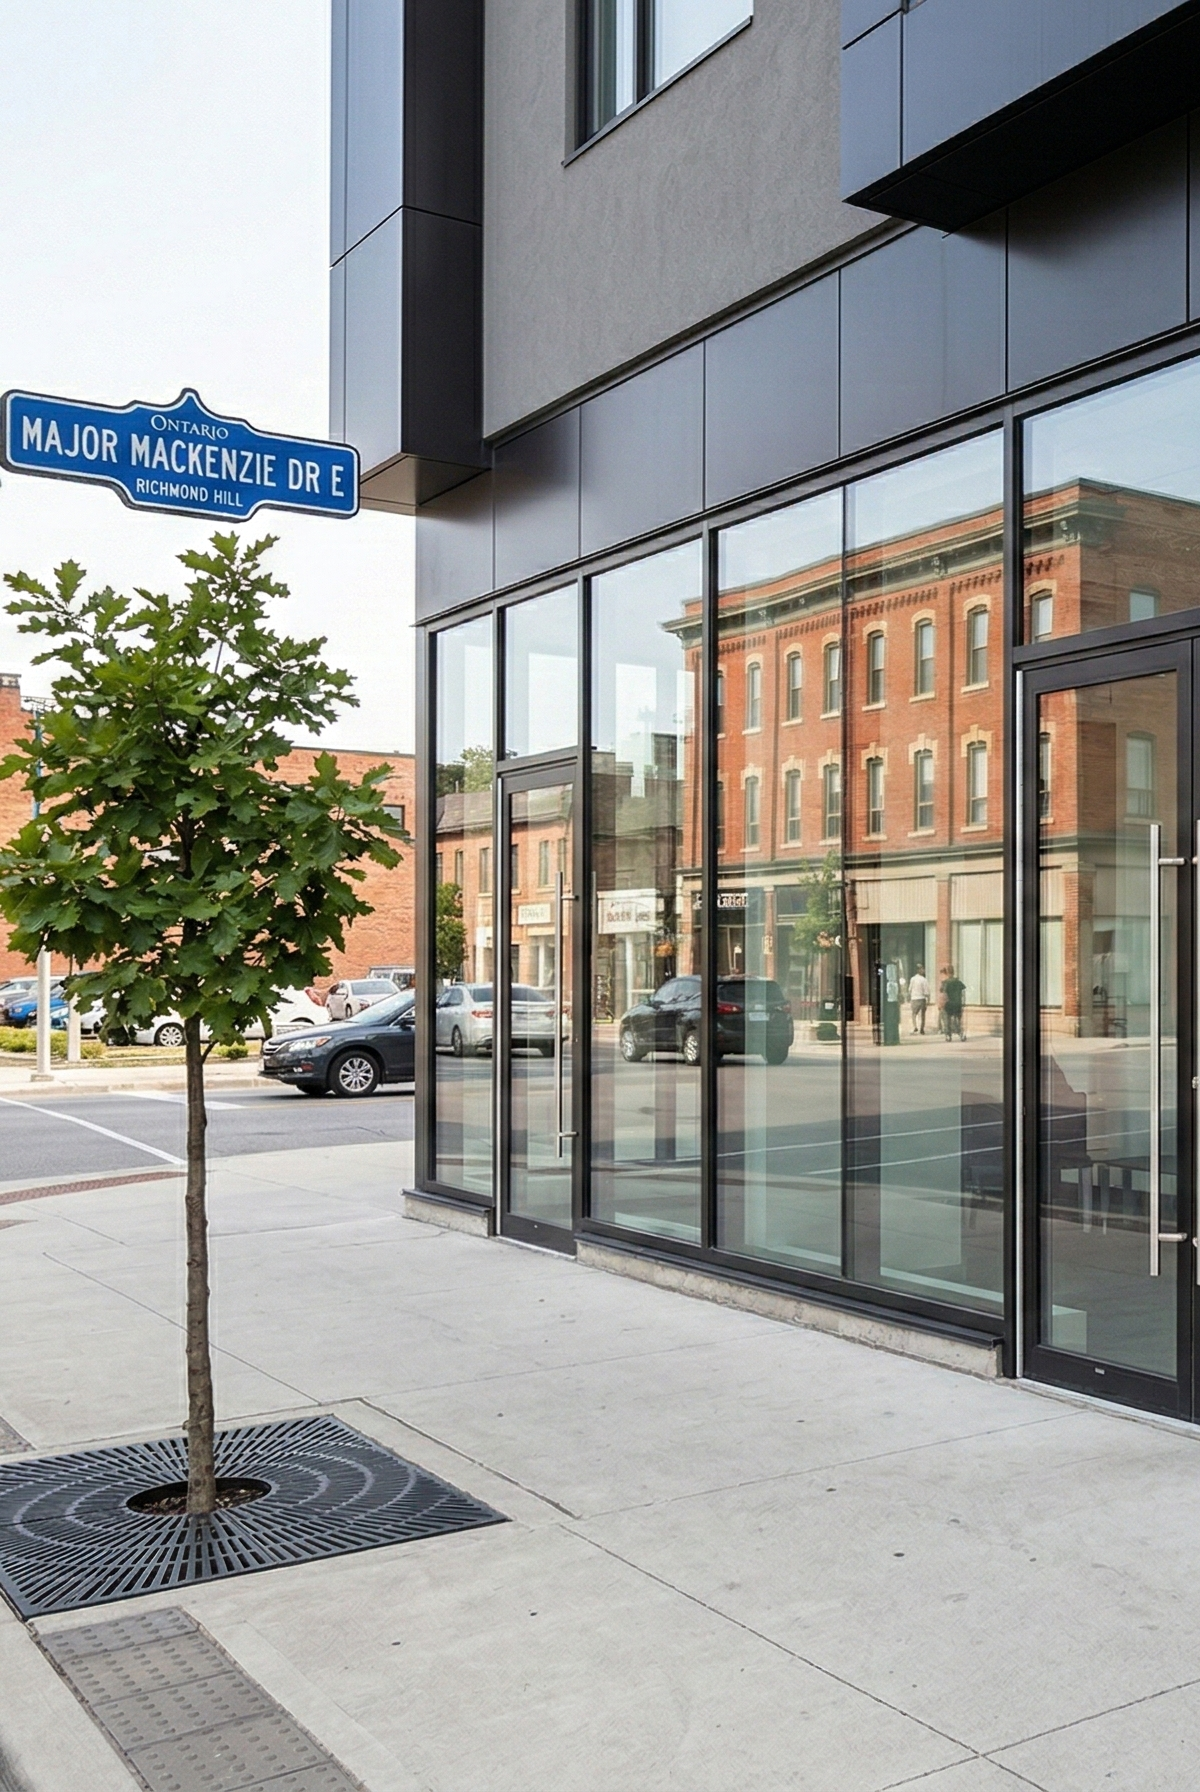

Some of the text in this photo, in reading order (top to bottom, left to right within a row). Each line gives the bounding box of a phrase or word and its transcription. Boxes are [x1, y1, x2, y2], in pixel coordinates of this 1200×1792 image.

[22, 415, 345, 497] MAJOR MACKENZIE DR E
[136, 478, 244, 508] RICHMOND HILL
